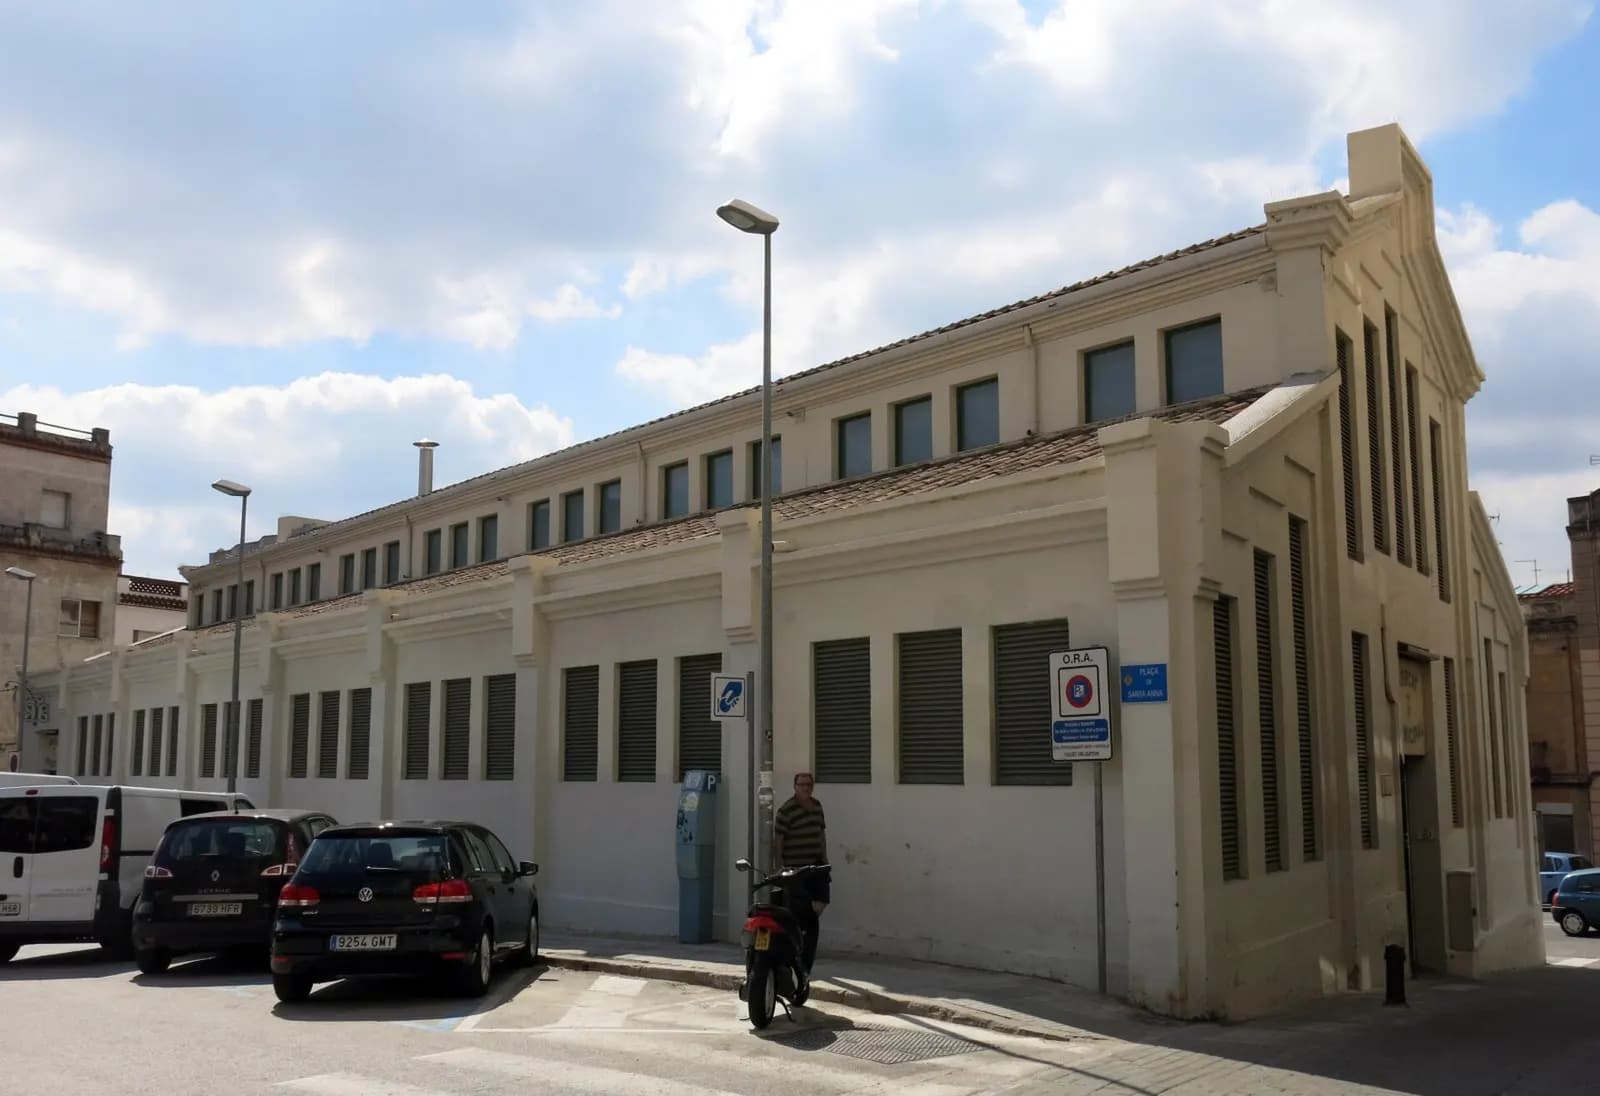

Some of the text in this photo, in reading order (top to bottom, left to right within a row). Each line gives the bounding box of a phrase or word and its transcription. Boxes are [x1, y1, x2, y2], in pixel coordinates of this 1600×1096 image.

[1062, 653, 1093, 665] O.R.A.
[338, 935, 395, 948] 9254 GMT
